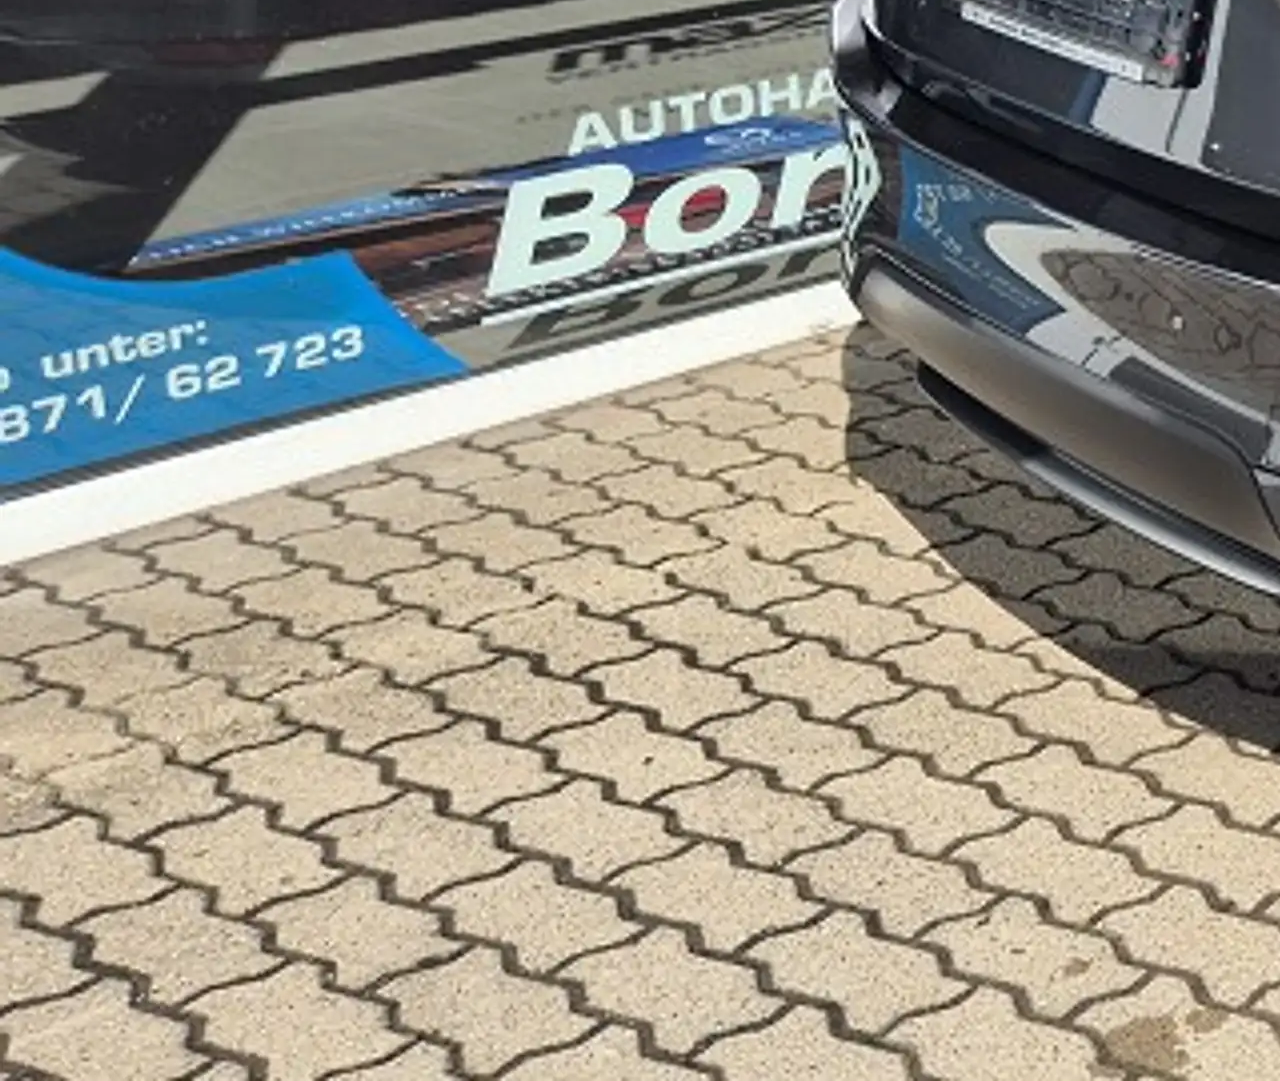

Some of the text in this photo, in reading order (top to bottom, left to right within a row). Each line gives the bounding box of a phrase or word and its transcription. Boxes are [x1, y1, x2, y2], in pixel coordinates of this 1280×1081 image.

[40, 318, 209, 380] unter:
[165, 354, 242, 401] 62
[255, 324, 365, 379] 723
